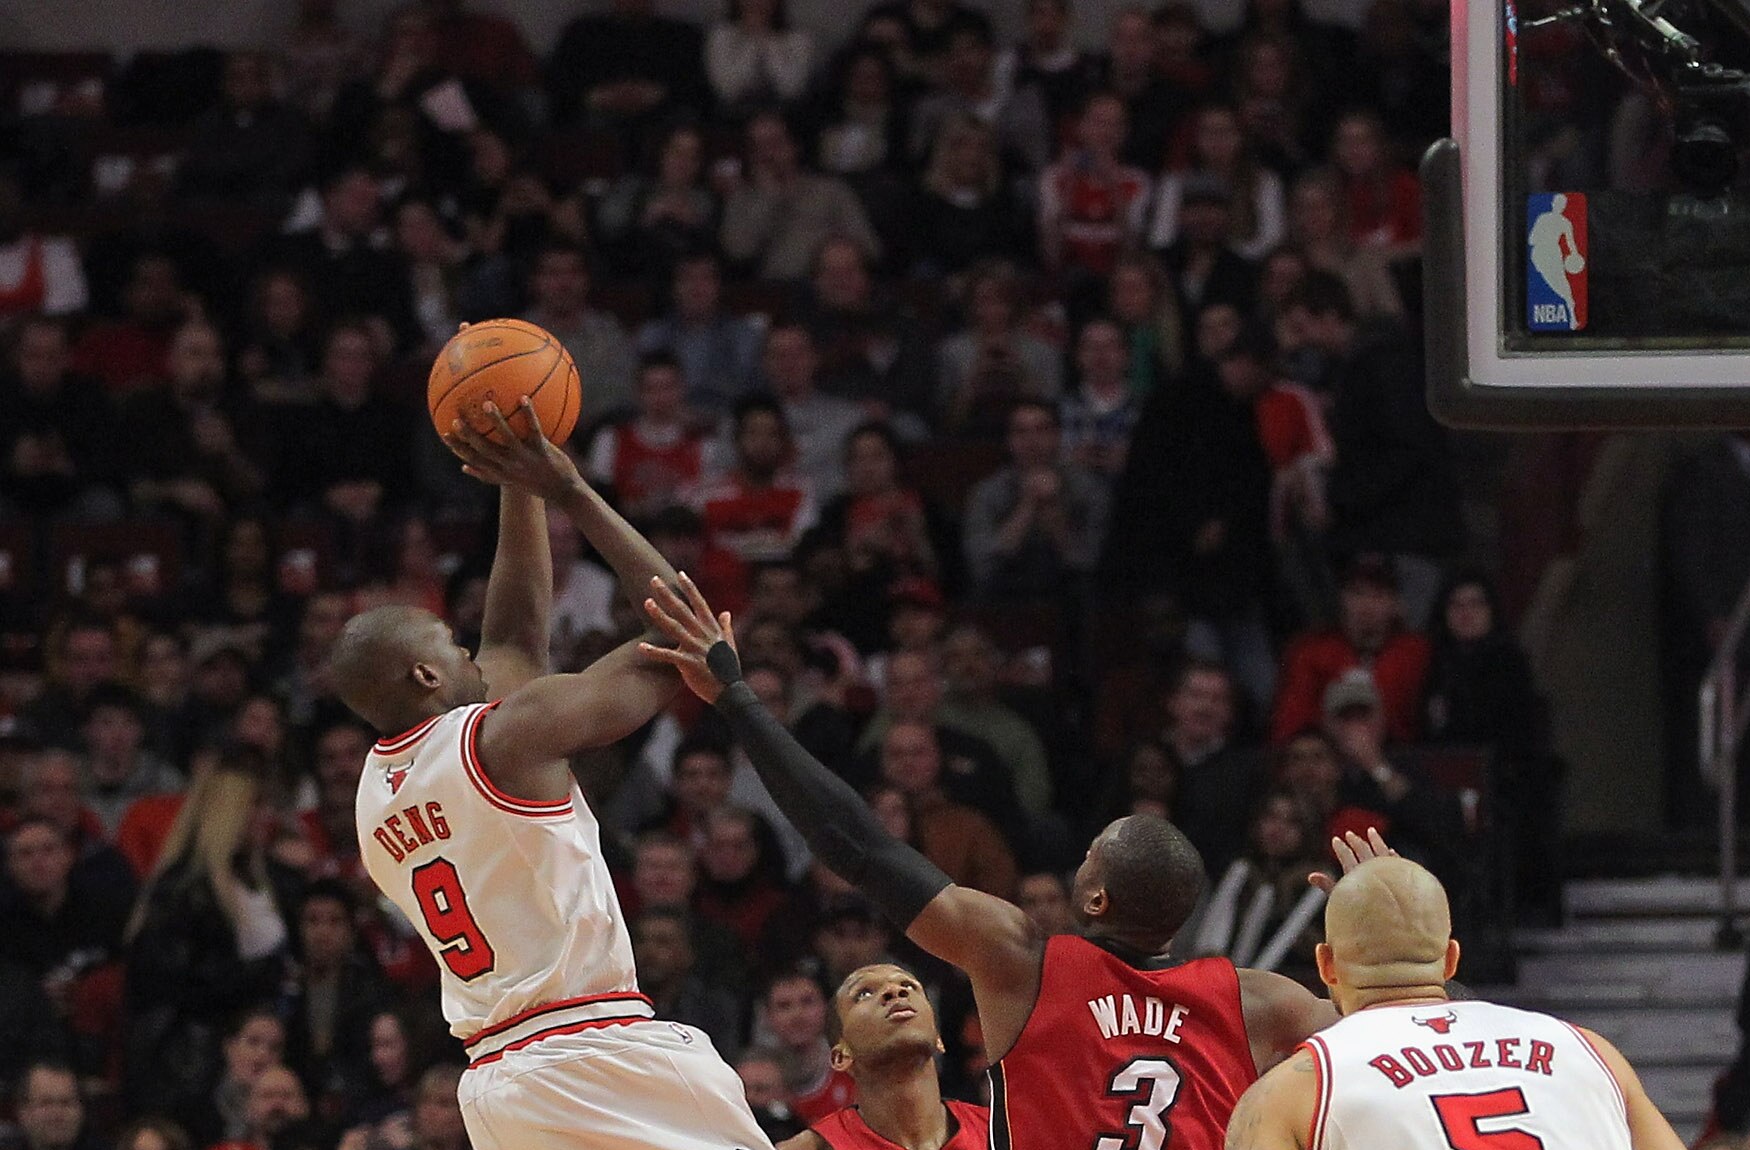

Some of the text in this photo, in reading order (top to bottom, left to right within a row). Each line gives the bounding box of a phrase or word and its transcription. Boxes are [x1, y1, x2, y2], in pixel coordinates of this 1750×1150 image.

[1533, 303, 1568, 323] NBA
[373, 801, 452, 864] DENG
[411, 856, 496, 983] 9
[1087, 993, 1191, 1044] WADE
[1367, 1037, 1556, 1090] BOOZER
